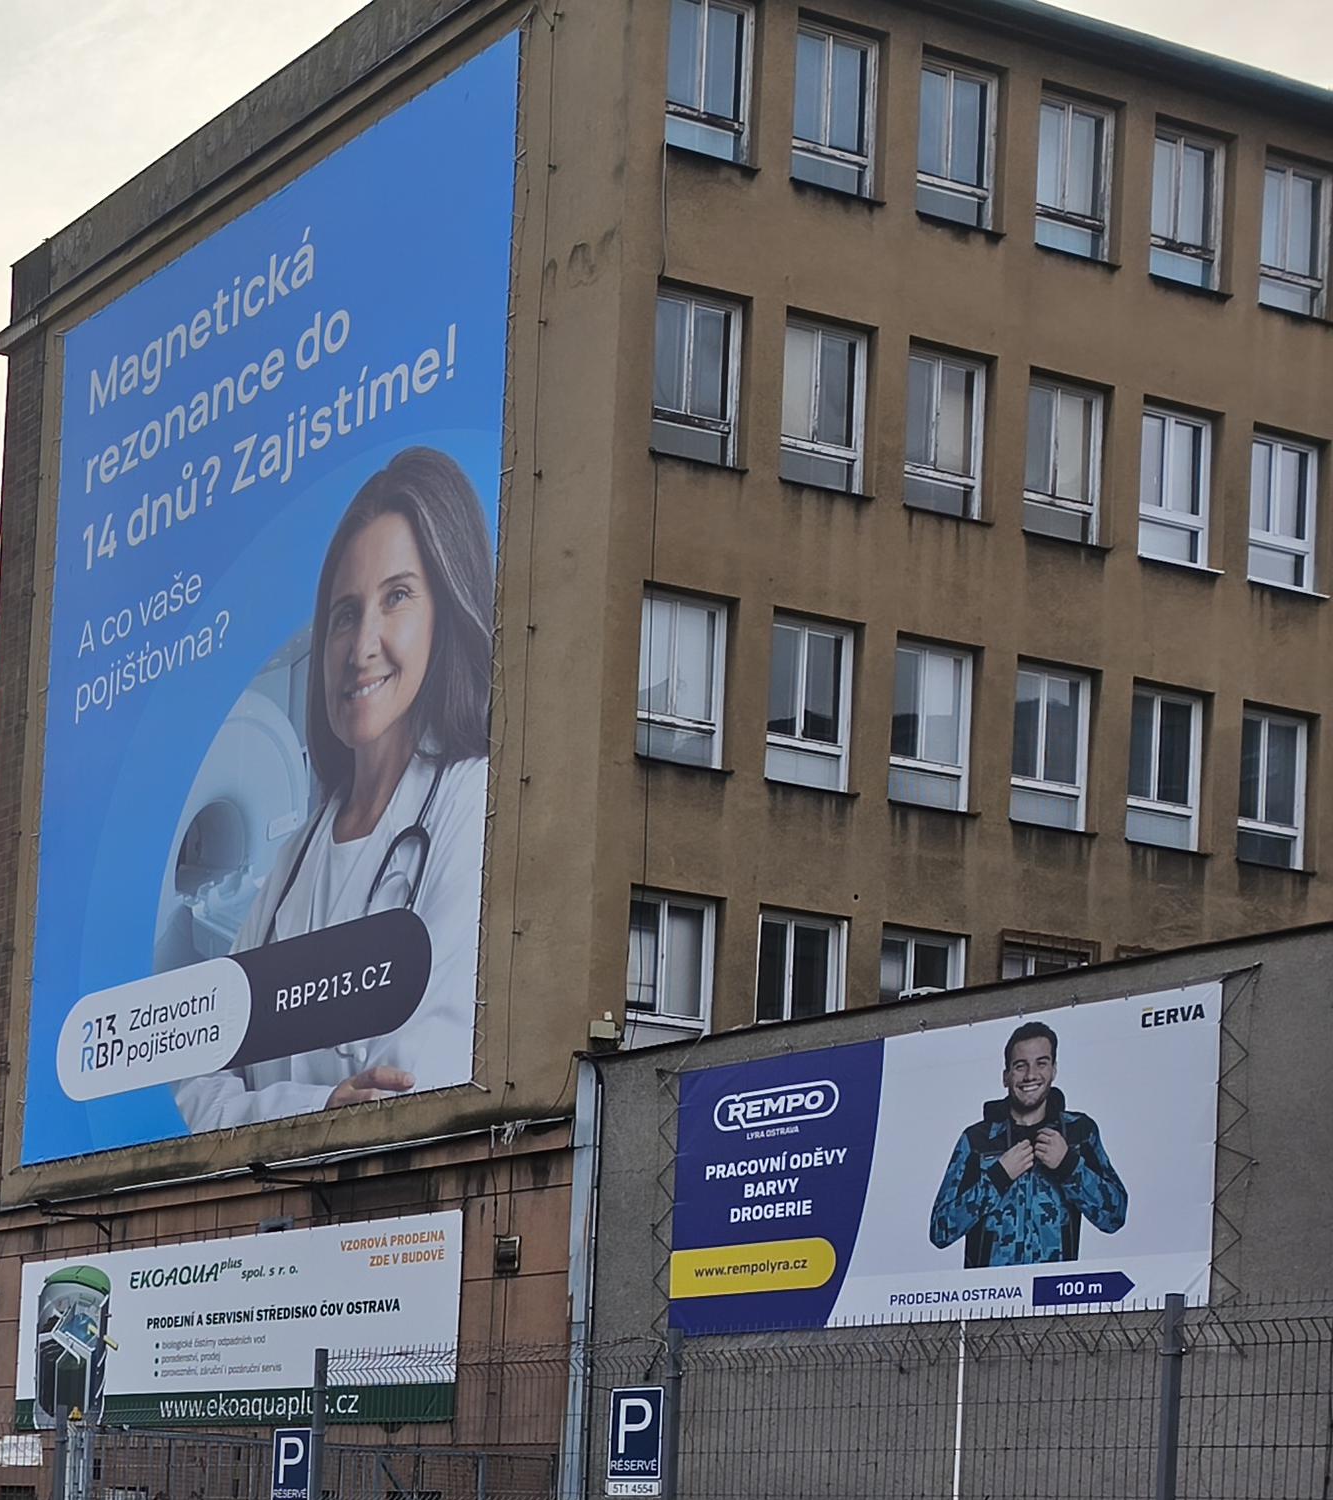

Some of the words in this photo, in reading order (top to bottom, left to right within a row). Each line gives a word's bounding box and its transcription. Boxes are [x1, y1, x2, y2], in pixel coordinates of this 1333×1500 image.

[88, 226, 316, 415] Magnetická
[84, 347, 284, 494] rezonance
[295, 308, 351, 370] do
[82, 512, 118, 571] 14
[125, 455, 221, 547] dnů?
[230, 323, 458, 495] Zajistíme!
[77, 621, 95, 659] A
[101, 607, 133, 648] co
[138, 572, 203, 627] vaše
[73, 609, 231, 724] pojišťovna?
[275, 960, 392, 1013] RBP213.CZ
[129, 986, 218, 1032] Zdravotní
[81, 1013, 118, 1044] 213
[126, 1023, 220, 1067] pojišťovna
[80, 1039, 124, 1073] RBP
[727, 1090, 825, 1124] REMPO
[746, 1129, 765, 1141] LYRA
[765, 1125, 800, 1138] OSTRAVA
[705, 1151, 788, 1181] PRACOVNÍ
[789, 1146, 848, 1170] ODĚVY
[743, 1177, 800, 1199] BARVY
[729, 1199, 813, 1223] DROGERIE
[340, 1232, 388, 1252] VZOROVÁ
[390, 1230, 446, 1247] PRODEJNA
[369, 1254, 390, 1267] ZDE
[392, 1253, 400, 1265] V
[401, 1245, 445, 1265] BUDOVĚ
[241, 1265, 266, 1282] spol.
[269, 1267, 275, 1276] s
[289, 1265, 299, 1275] o.
[694, 1258, 808, 1278] www.rempolyra.cz
[889, 1290, 960, 1306] PRODEJNA
[962, 1286, 1023, 1302] OSTRAVA
[1055, 1281, 1084, 1296] 100
[1088, 1282, 1103, 1294] m
[146, 1311, 196, 1330] PRODEJNÍ
[196, 1313, 204, 1326] A
[205, 1306, 255, 1326] SERVISNÍ
[256, 1304, 317, 1323] STŘEDISKO
[319, 1300, 344, 1317] ČOV
[346, 1298, 401, 1315] OSTRAVA
[617, 1397, 653, 1454] P
[278, 1436, 305, 1484] P
